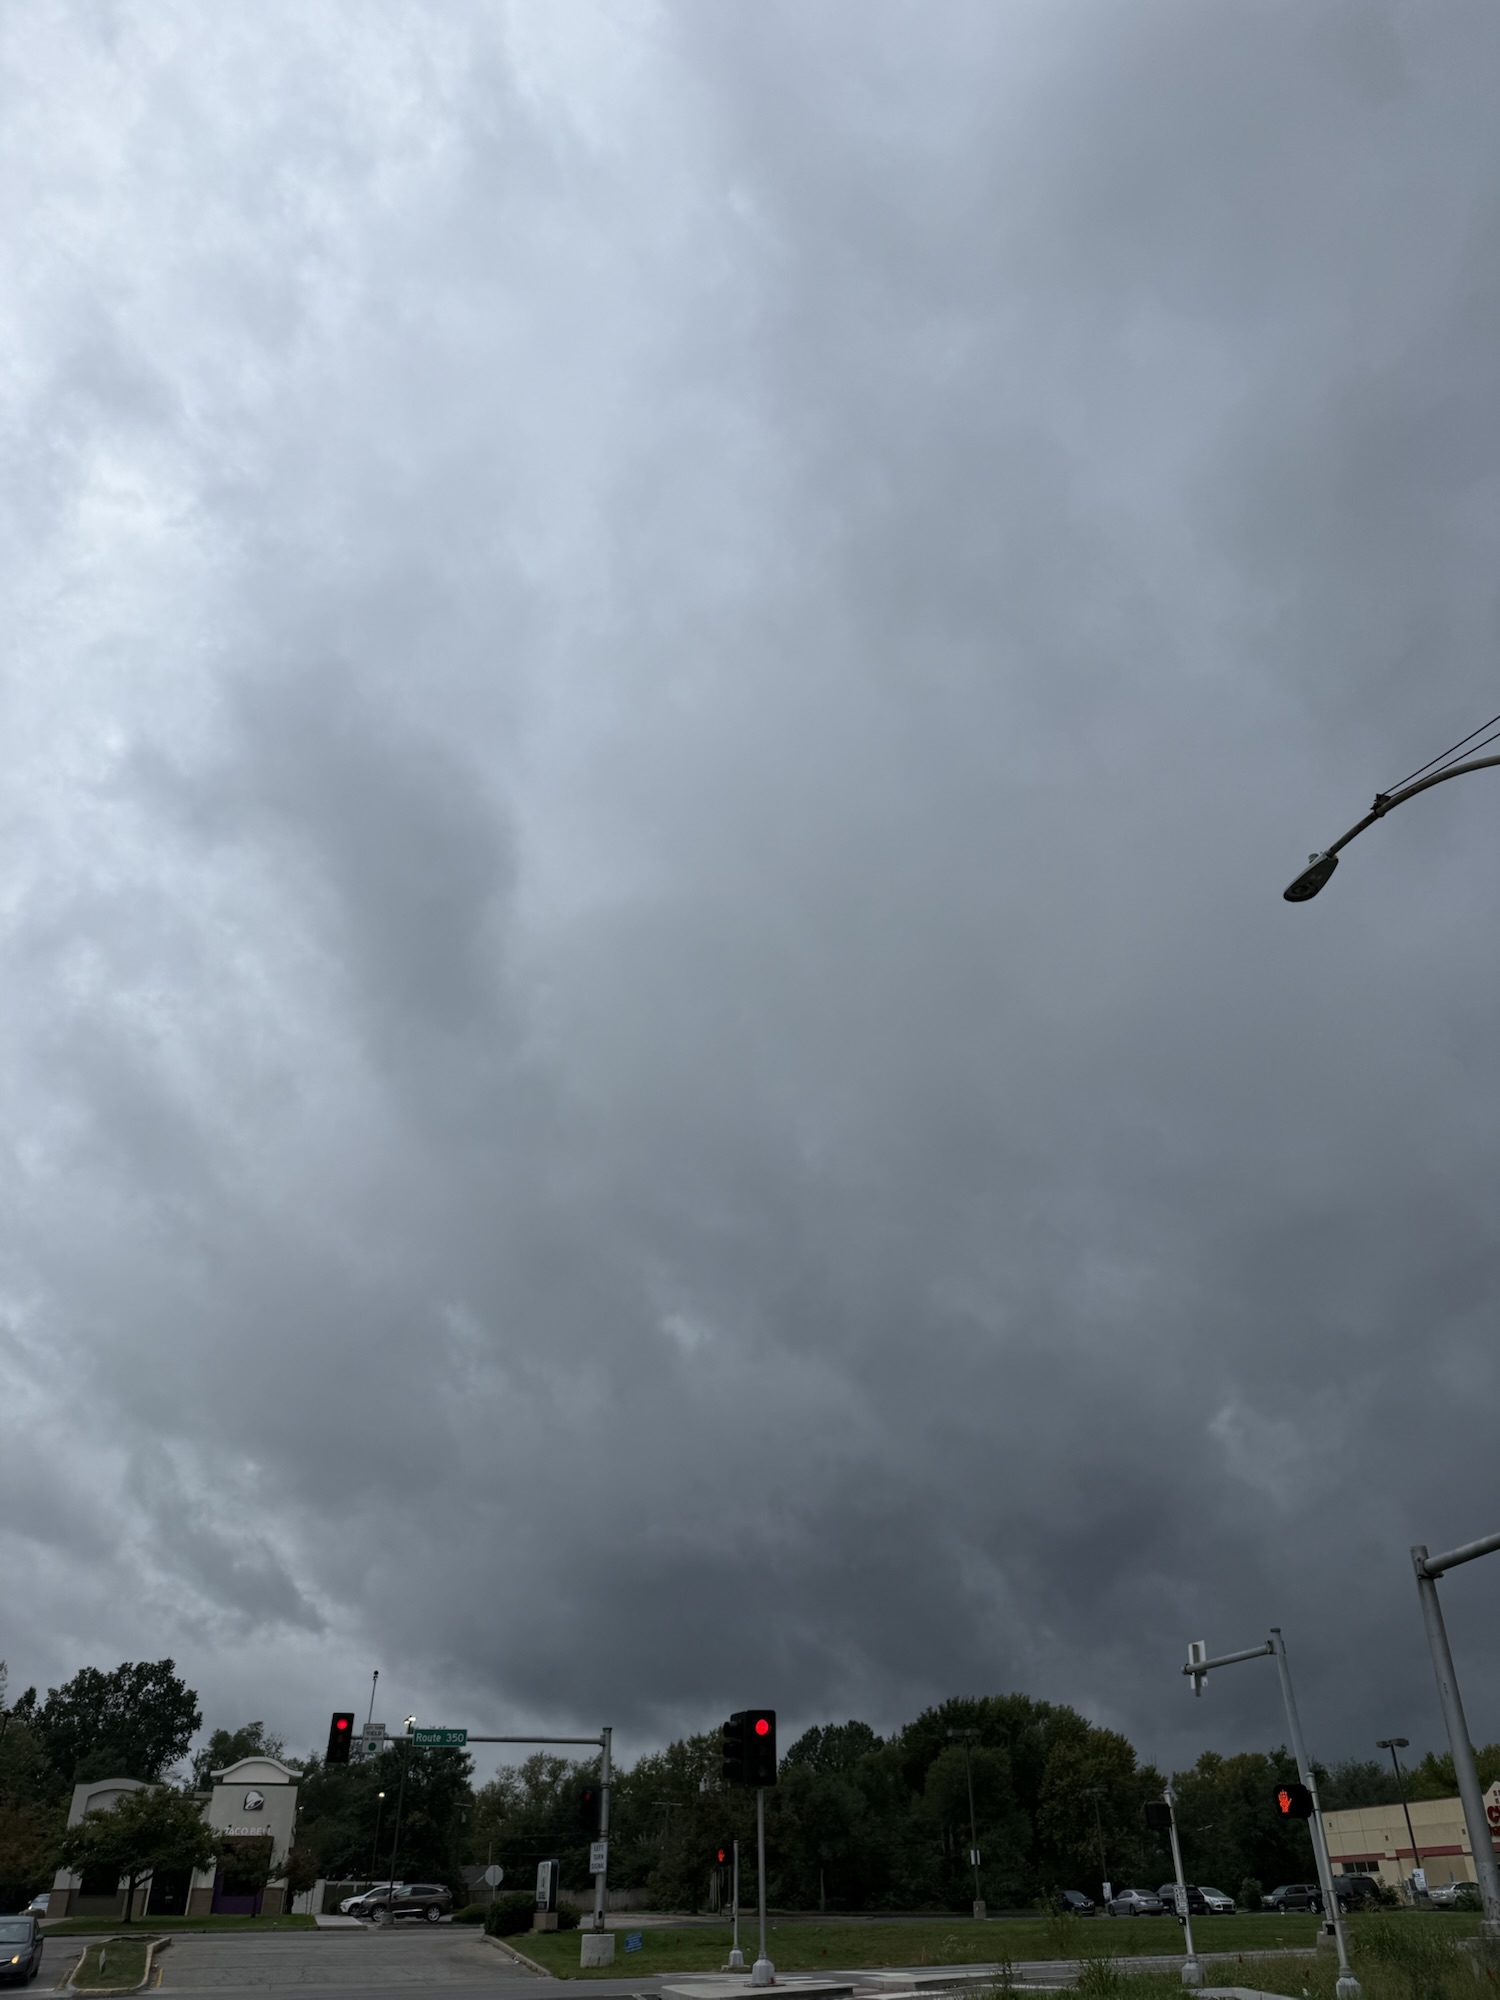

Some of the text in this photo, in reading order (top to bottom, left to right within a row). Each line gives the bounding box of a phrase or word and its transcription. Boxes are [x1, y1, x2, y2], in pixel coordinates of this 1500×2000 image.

[416, 1732, 464, 1743] Route 350
[224, 1827, 272, 1835] TACO BELL
